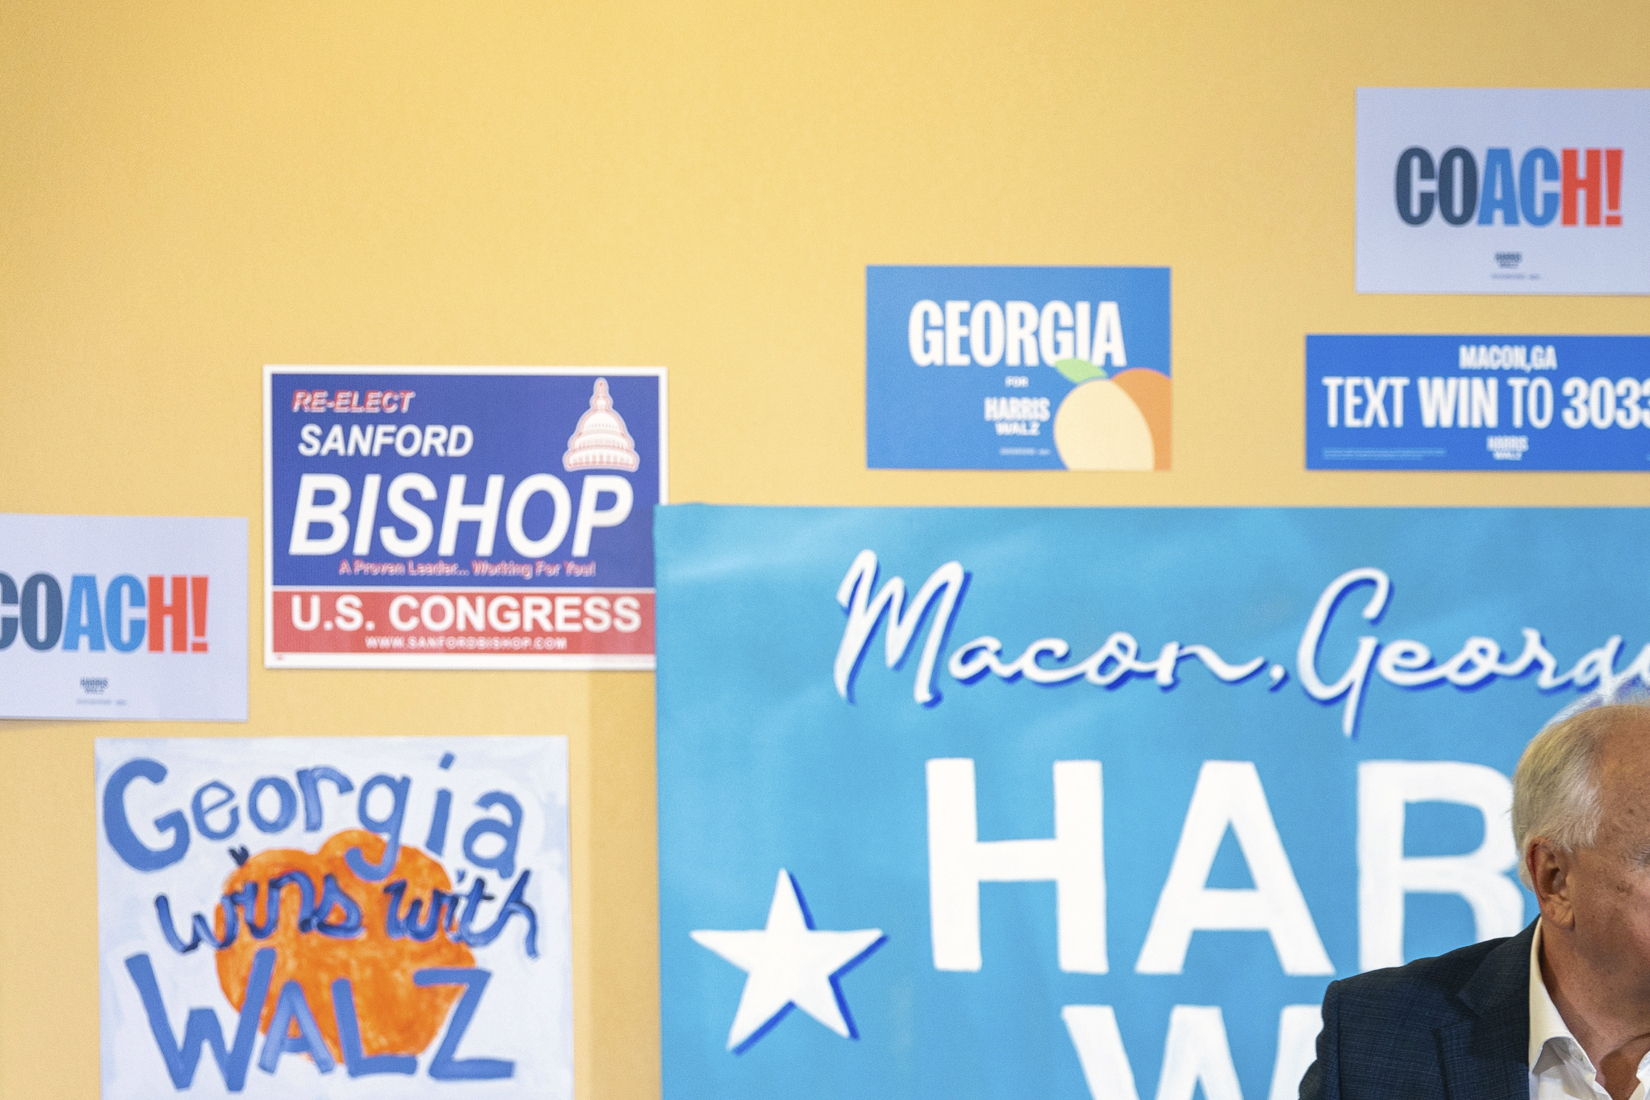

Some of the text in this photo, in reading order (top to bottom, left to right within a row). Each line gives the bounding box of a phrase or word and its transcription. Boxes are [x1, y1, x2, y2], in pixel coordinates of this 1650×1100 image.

[1394, 146, 1625, 228] COACH!
[908, 299, 1128, 367] GEORGIA
[292, 389, 416, 414] RE-ELECT
[1005, 376, 1029, 388] FOR
[984, 397, 1051, 422] HARRIS
[1322, 376, 1410, 429] TEXT
[1417, 376, 1499, 429] WIN
[1507, 376, 1555, 430] TO
[298, 424, 475, 458] SANFORD
[995, 422, 1041, 436] WALZ
[288, 472, 635, 558] BISHOP
[339, 559, 352, 576] A
[354, 559, 406, 577] Proven
[472, 560, 533, 580] Working
[535, 560, 561, 577] For
[291, 594, 642, 634] U.S. CONGRESS
[102, 751, 525, 882] Georgia
[125, 946, 516, 1095] WALZ
